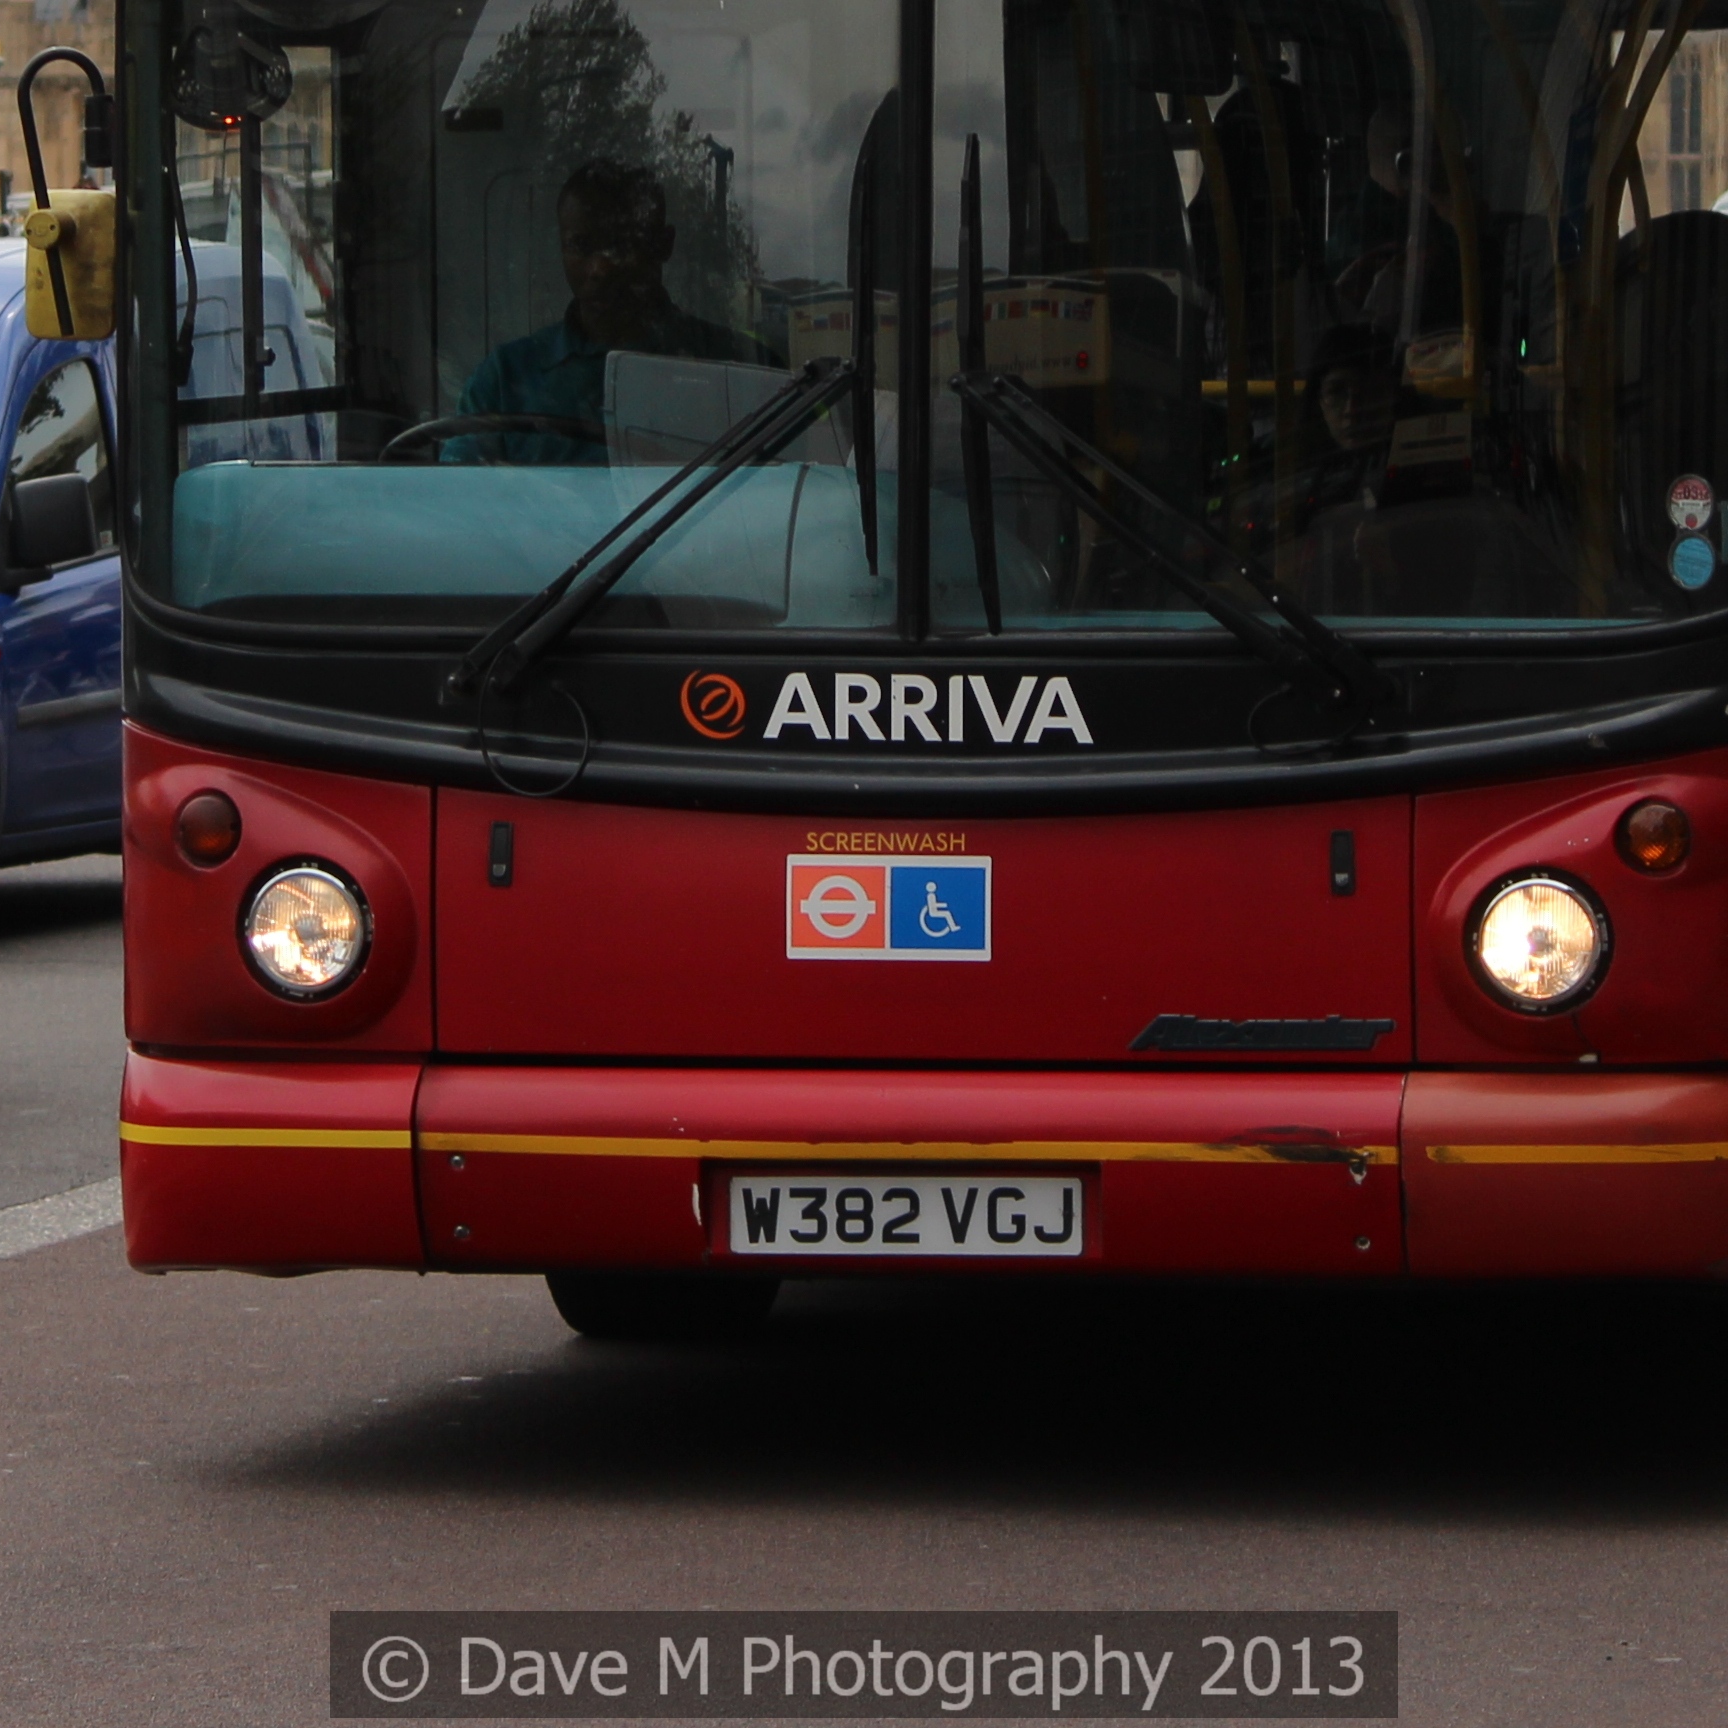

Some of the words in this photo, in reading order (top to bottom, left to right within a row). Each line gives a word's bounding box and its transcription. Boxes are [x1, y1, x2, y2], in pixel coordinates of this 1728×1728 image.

[763, 672, 1094, 744] ARRIVA
[805, 832, 967, 853] SCREENWASH
[742, 1188, 922, 1245] W382
[941, 1187, 1076, 1245] VGJ
